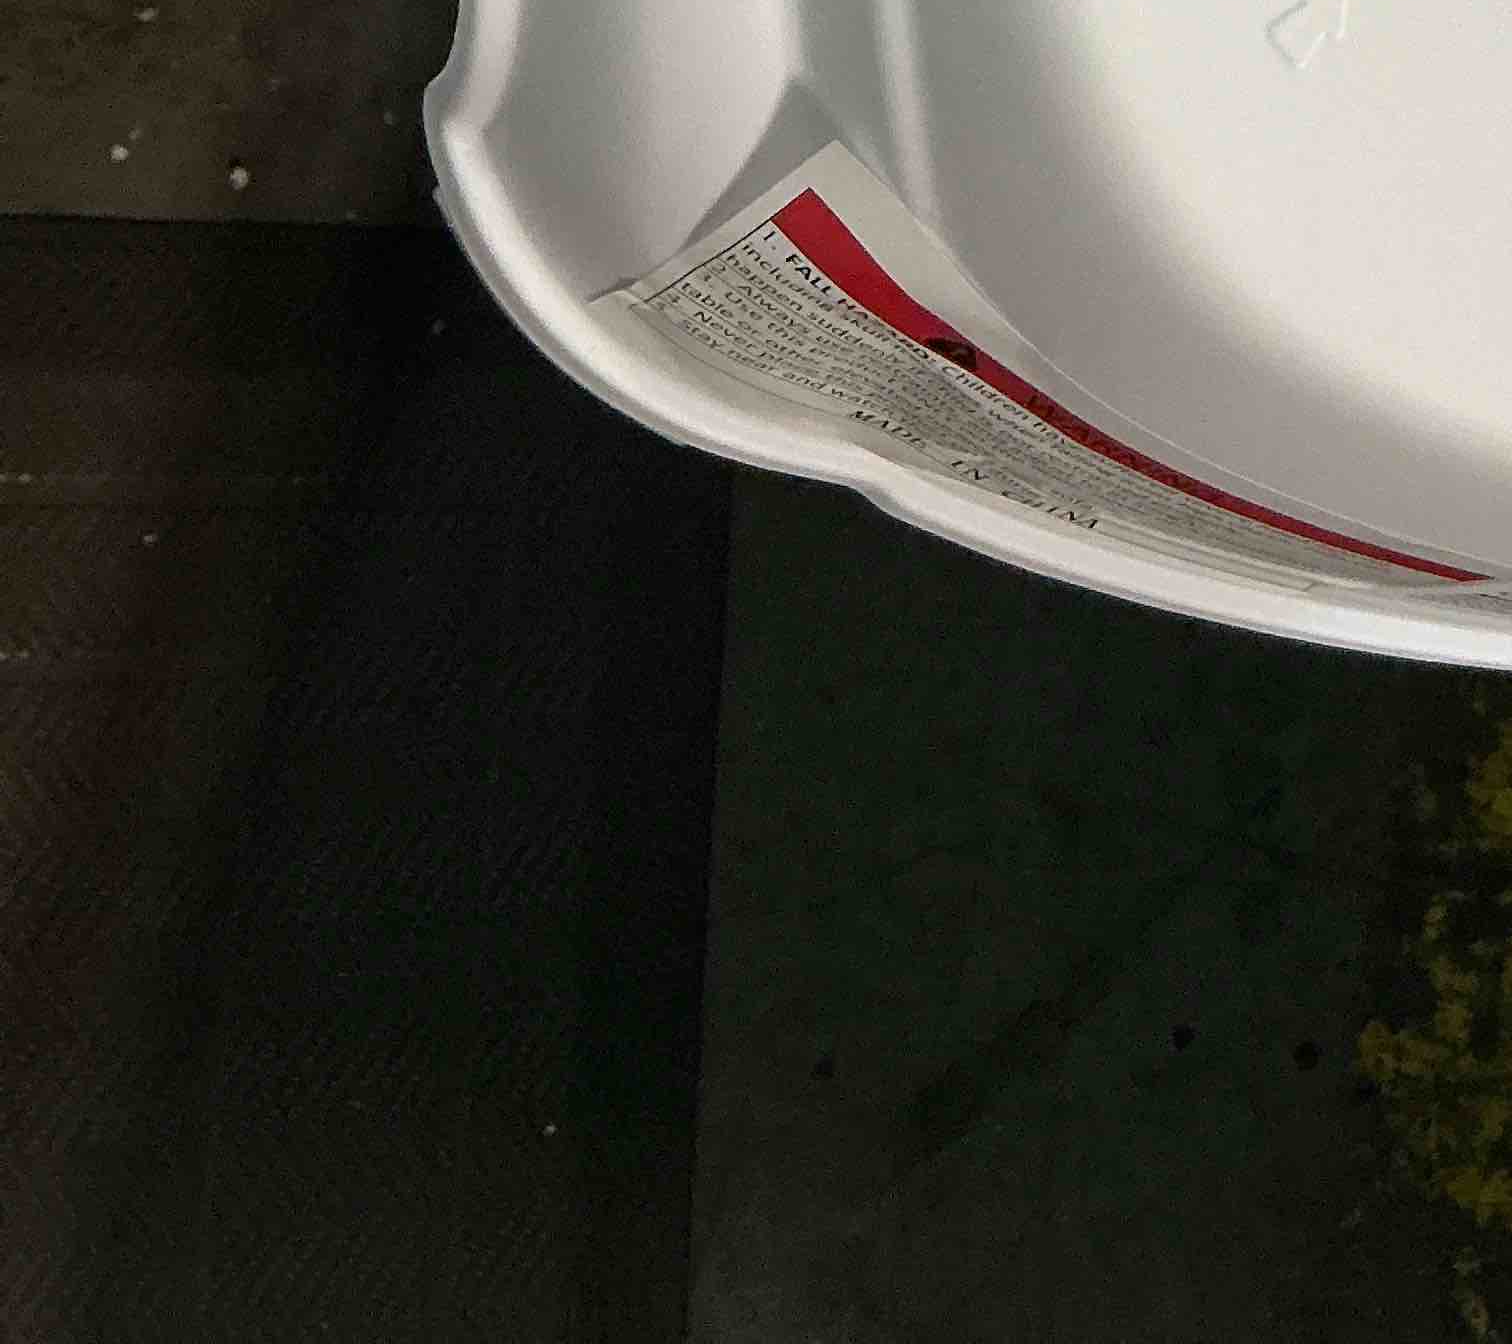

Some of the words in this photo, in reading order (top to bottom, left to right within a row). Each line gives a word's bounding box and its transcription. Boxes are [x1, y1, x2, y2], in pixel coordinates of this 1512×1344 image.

[725, 254, 804, 312] happen
[785, 253, 832, 296] FALL
[680, 281, 735, 320] table
